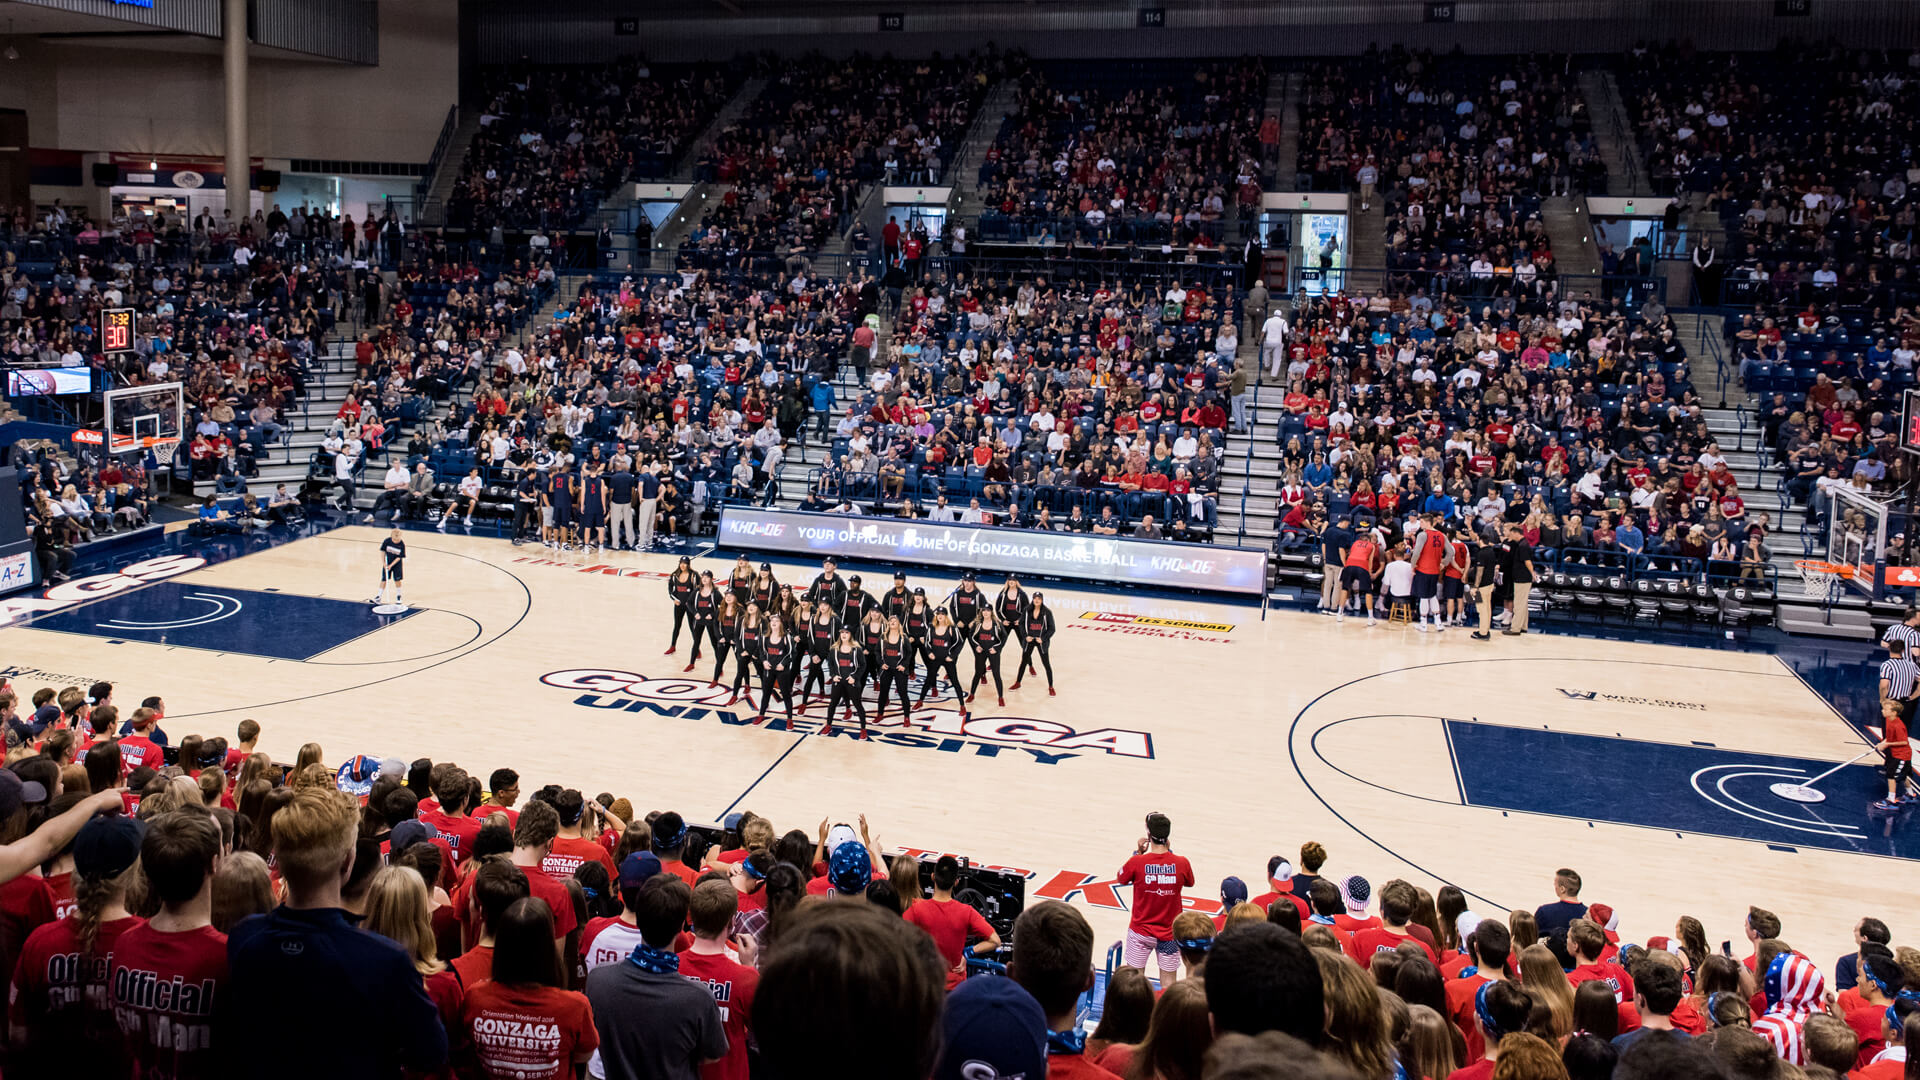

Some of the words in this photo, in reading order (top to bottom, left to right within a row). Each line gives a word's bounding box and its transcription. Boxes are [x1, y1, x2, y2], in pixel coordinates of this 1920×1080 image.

[1146, 13, 1160, 23] 114
[1434, 7, 1449, 17] 115
[623, 22, 635, 31] 112
[886, 17, 899, 27] 113
[110, 313, 129, 325] 7:32
[107, 326, 126, 347] 30
[730, 520, 757, 535] KHQ
[798, 526, 835, 542] YOUR
[838, 530, 899, 547] OFFICIAL
[947, 540, 966, 553] OF
[971, 543, 1040, 560] GONZAGA
[1043, 547, 1138, 568] BASKETBALL
[1151, 555, 1182, 573] KHQ
[573, 694, 1083, 765] UNIVERSITY
[1145, 863, 1176, 875] Official
[1145, 874, 1156, 884] 6th
[1157, 874, 1177, 884] Man
[115, 965, 216, 1016] Official
[115, 1006, 142, 1035] 6th
[148, 1014, 211, 1051] Man
[474, 1016, 561, 1040] GONZAGA
[473, 1031, 561, 1051] UNIVERSITY
